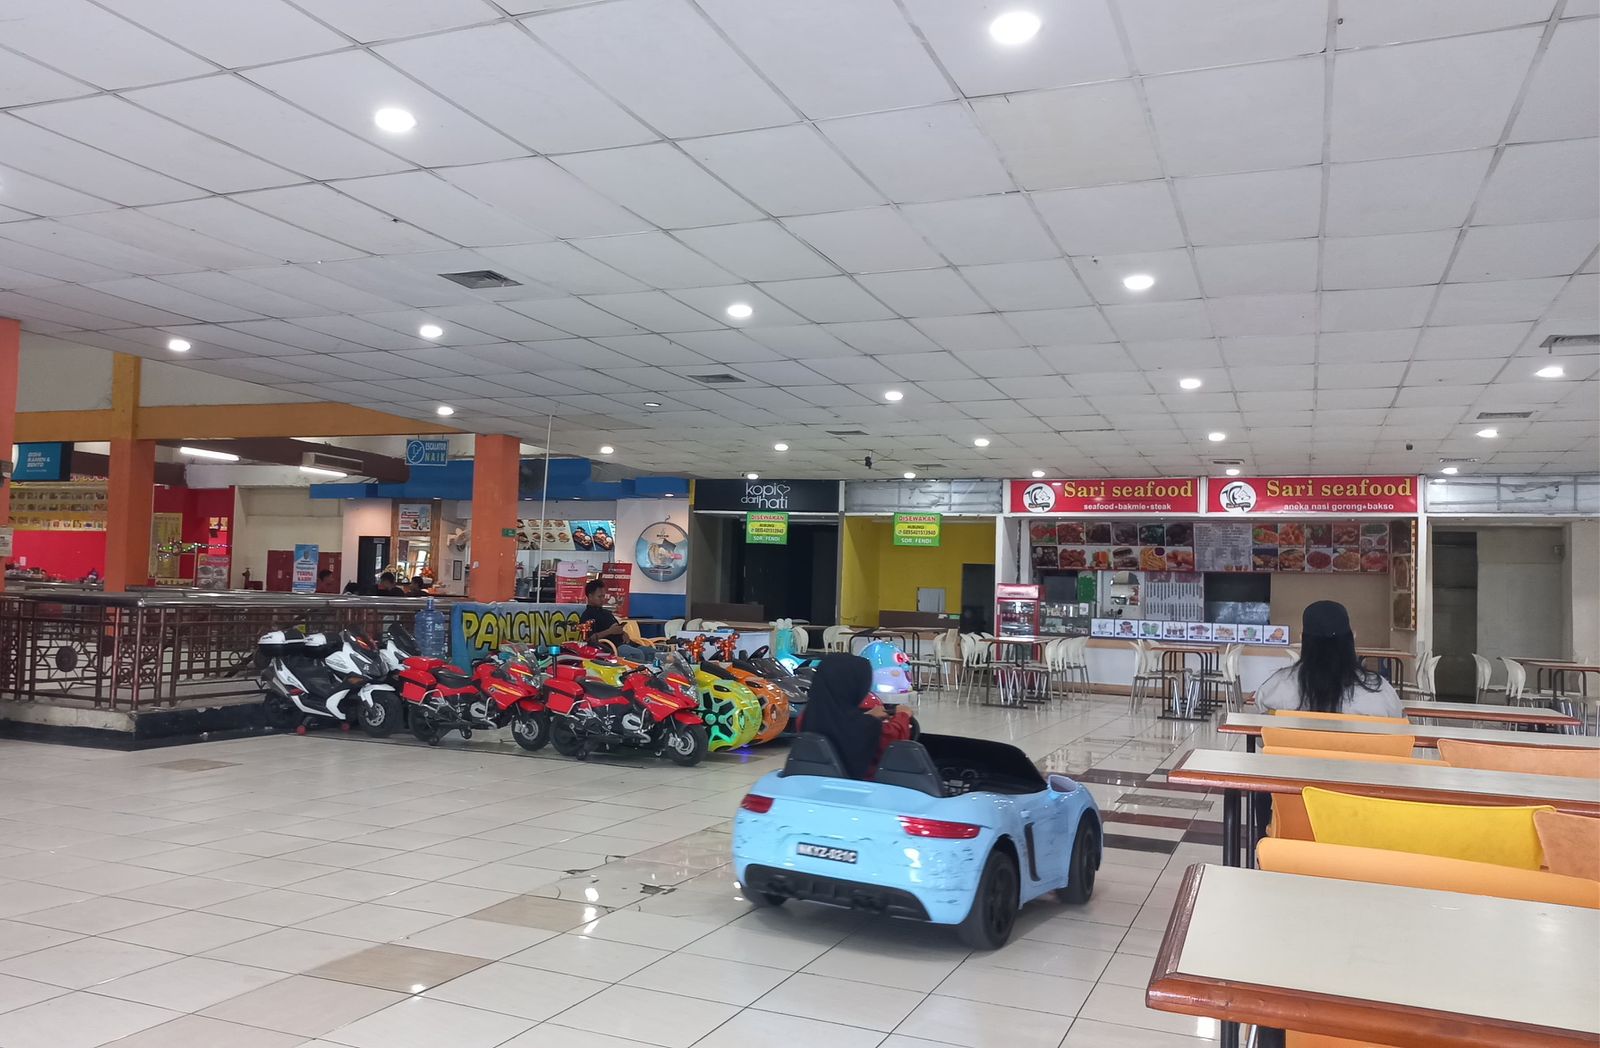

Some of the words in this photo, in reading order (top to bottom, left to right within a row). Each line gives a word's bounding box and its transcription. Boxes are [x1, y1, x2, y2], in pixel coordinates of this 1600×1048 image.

[425, 452, 446, 462] NAIK
[745, 482, 777, 498] kopi
[1064, 481, 1105, 497] Sari
[1112, 480, 1193, 498] seafood
[1266, 480, 1314, 497] Sari
[1321, 478, 1412, 497] seafood
[741, 495, 759, 504] dari
[758, 495, 788, 509] hati
